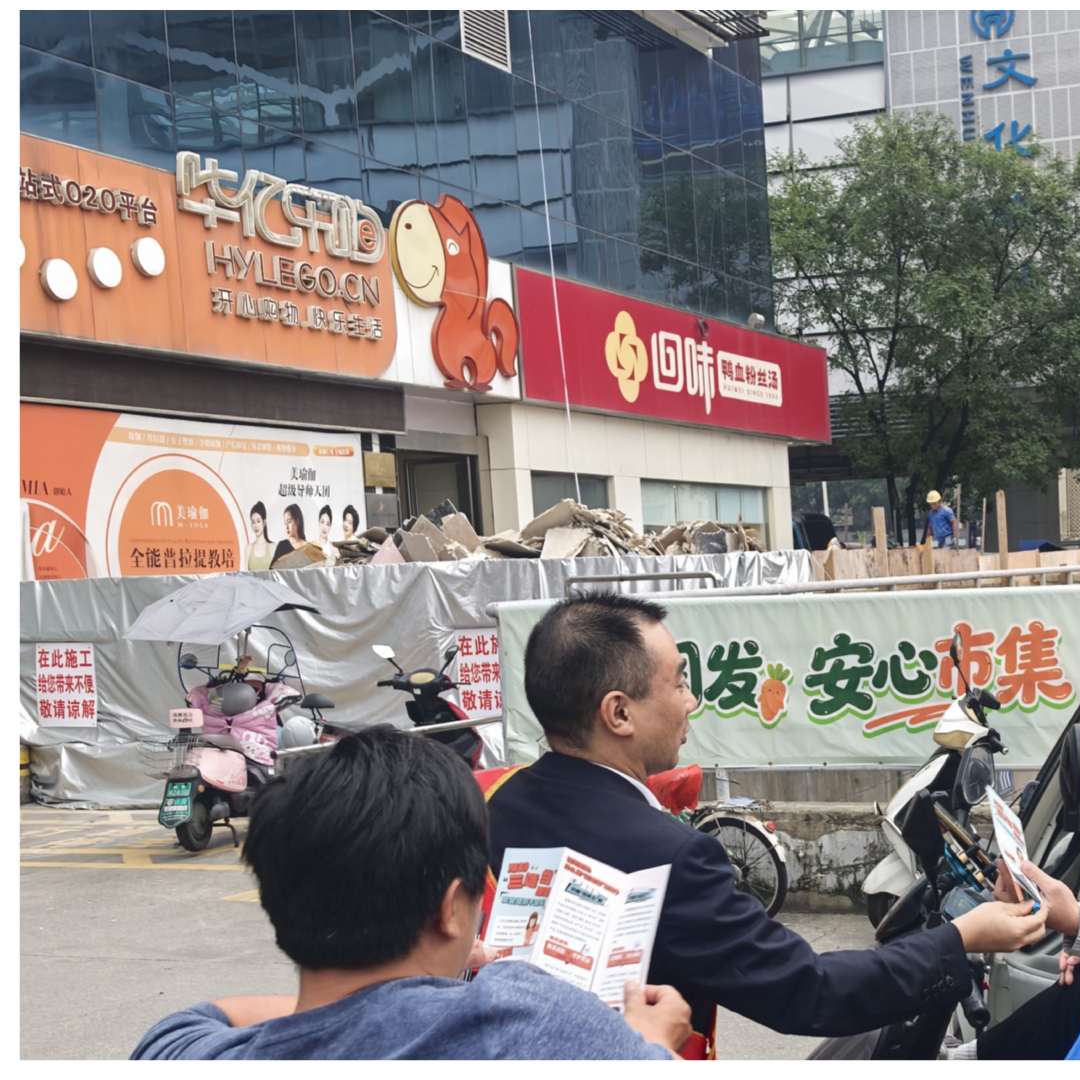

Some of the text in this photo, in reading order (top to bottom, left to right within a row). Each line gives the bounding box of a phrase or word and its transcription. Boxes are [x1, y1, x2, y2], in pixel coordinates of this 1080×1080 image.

[205, 240, 381, 307] HYLEGO.CN
[651, 330, 716, 414] 回味
[721, 359, 779, 391] 鸭血粉丝汤
[176, 504, 209, 520] 美瑜伽
[130, 547, 235, 569] 全能普拉提教培
[37, 649, 93, 668] 在此施工
[807, 621, 1073, 716] 安心市集
[37, 674, 95, 695] 给您带来不便
[38, 699, 96, 720] 敬请谅解
